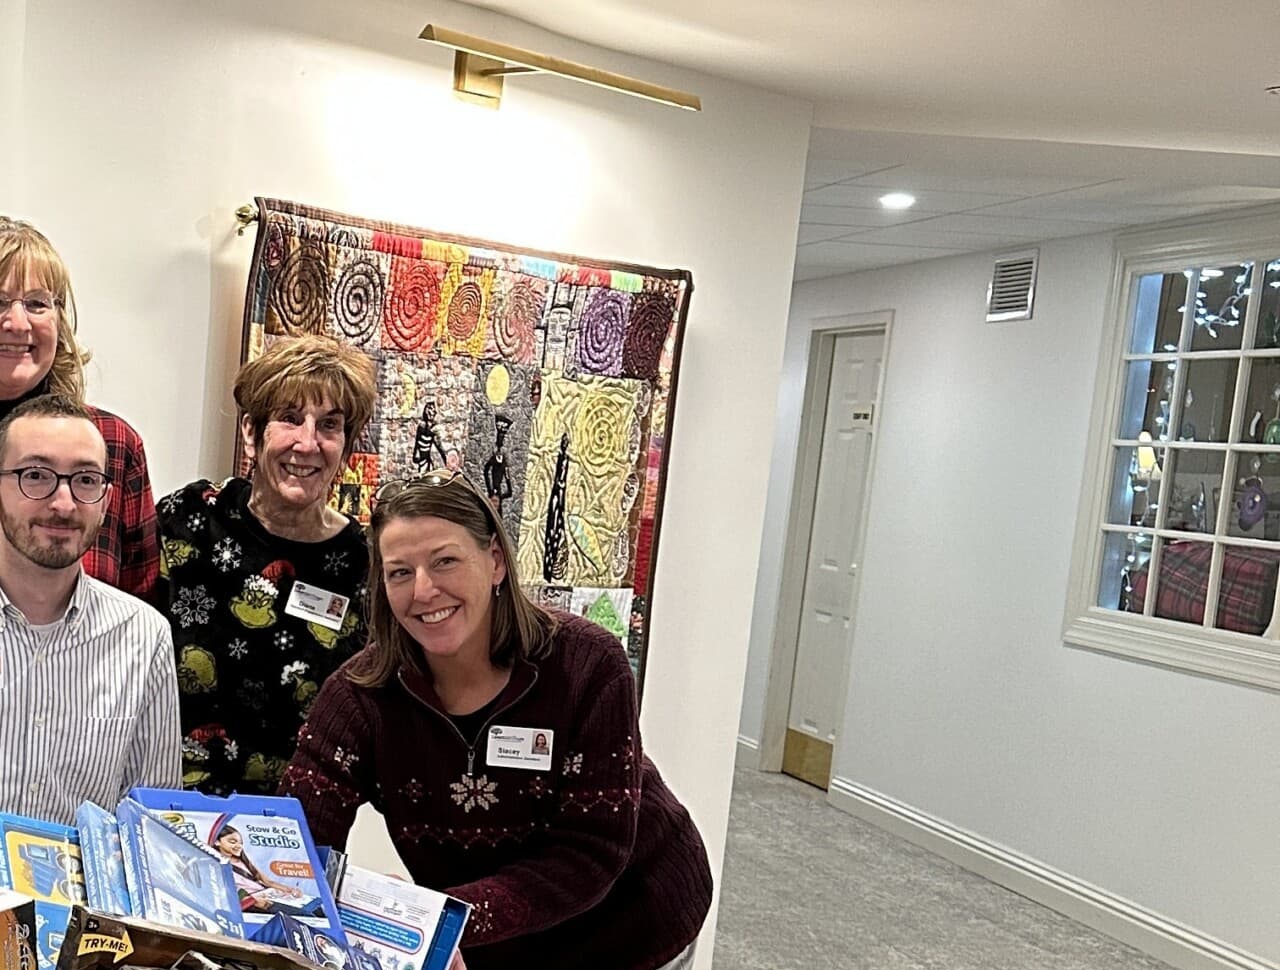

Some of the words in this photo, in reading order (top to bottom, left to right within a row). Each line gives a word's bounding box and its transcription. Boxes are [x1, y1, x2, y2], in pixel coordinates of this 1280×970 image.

[246, 825, 269, 833] Stow
[282, 827, 296, 835] Go
[249, 834, 300, 849] Studio
[278, 868, 309, 876] Travel!
[84, 938, 129, 953] TRY-ME!
